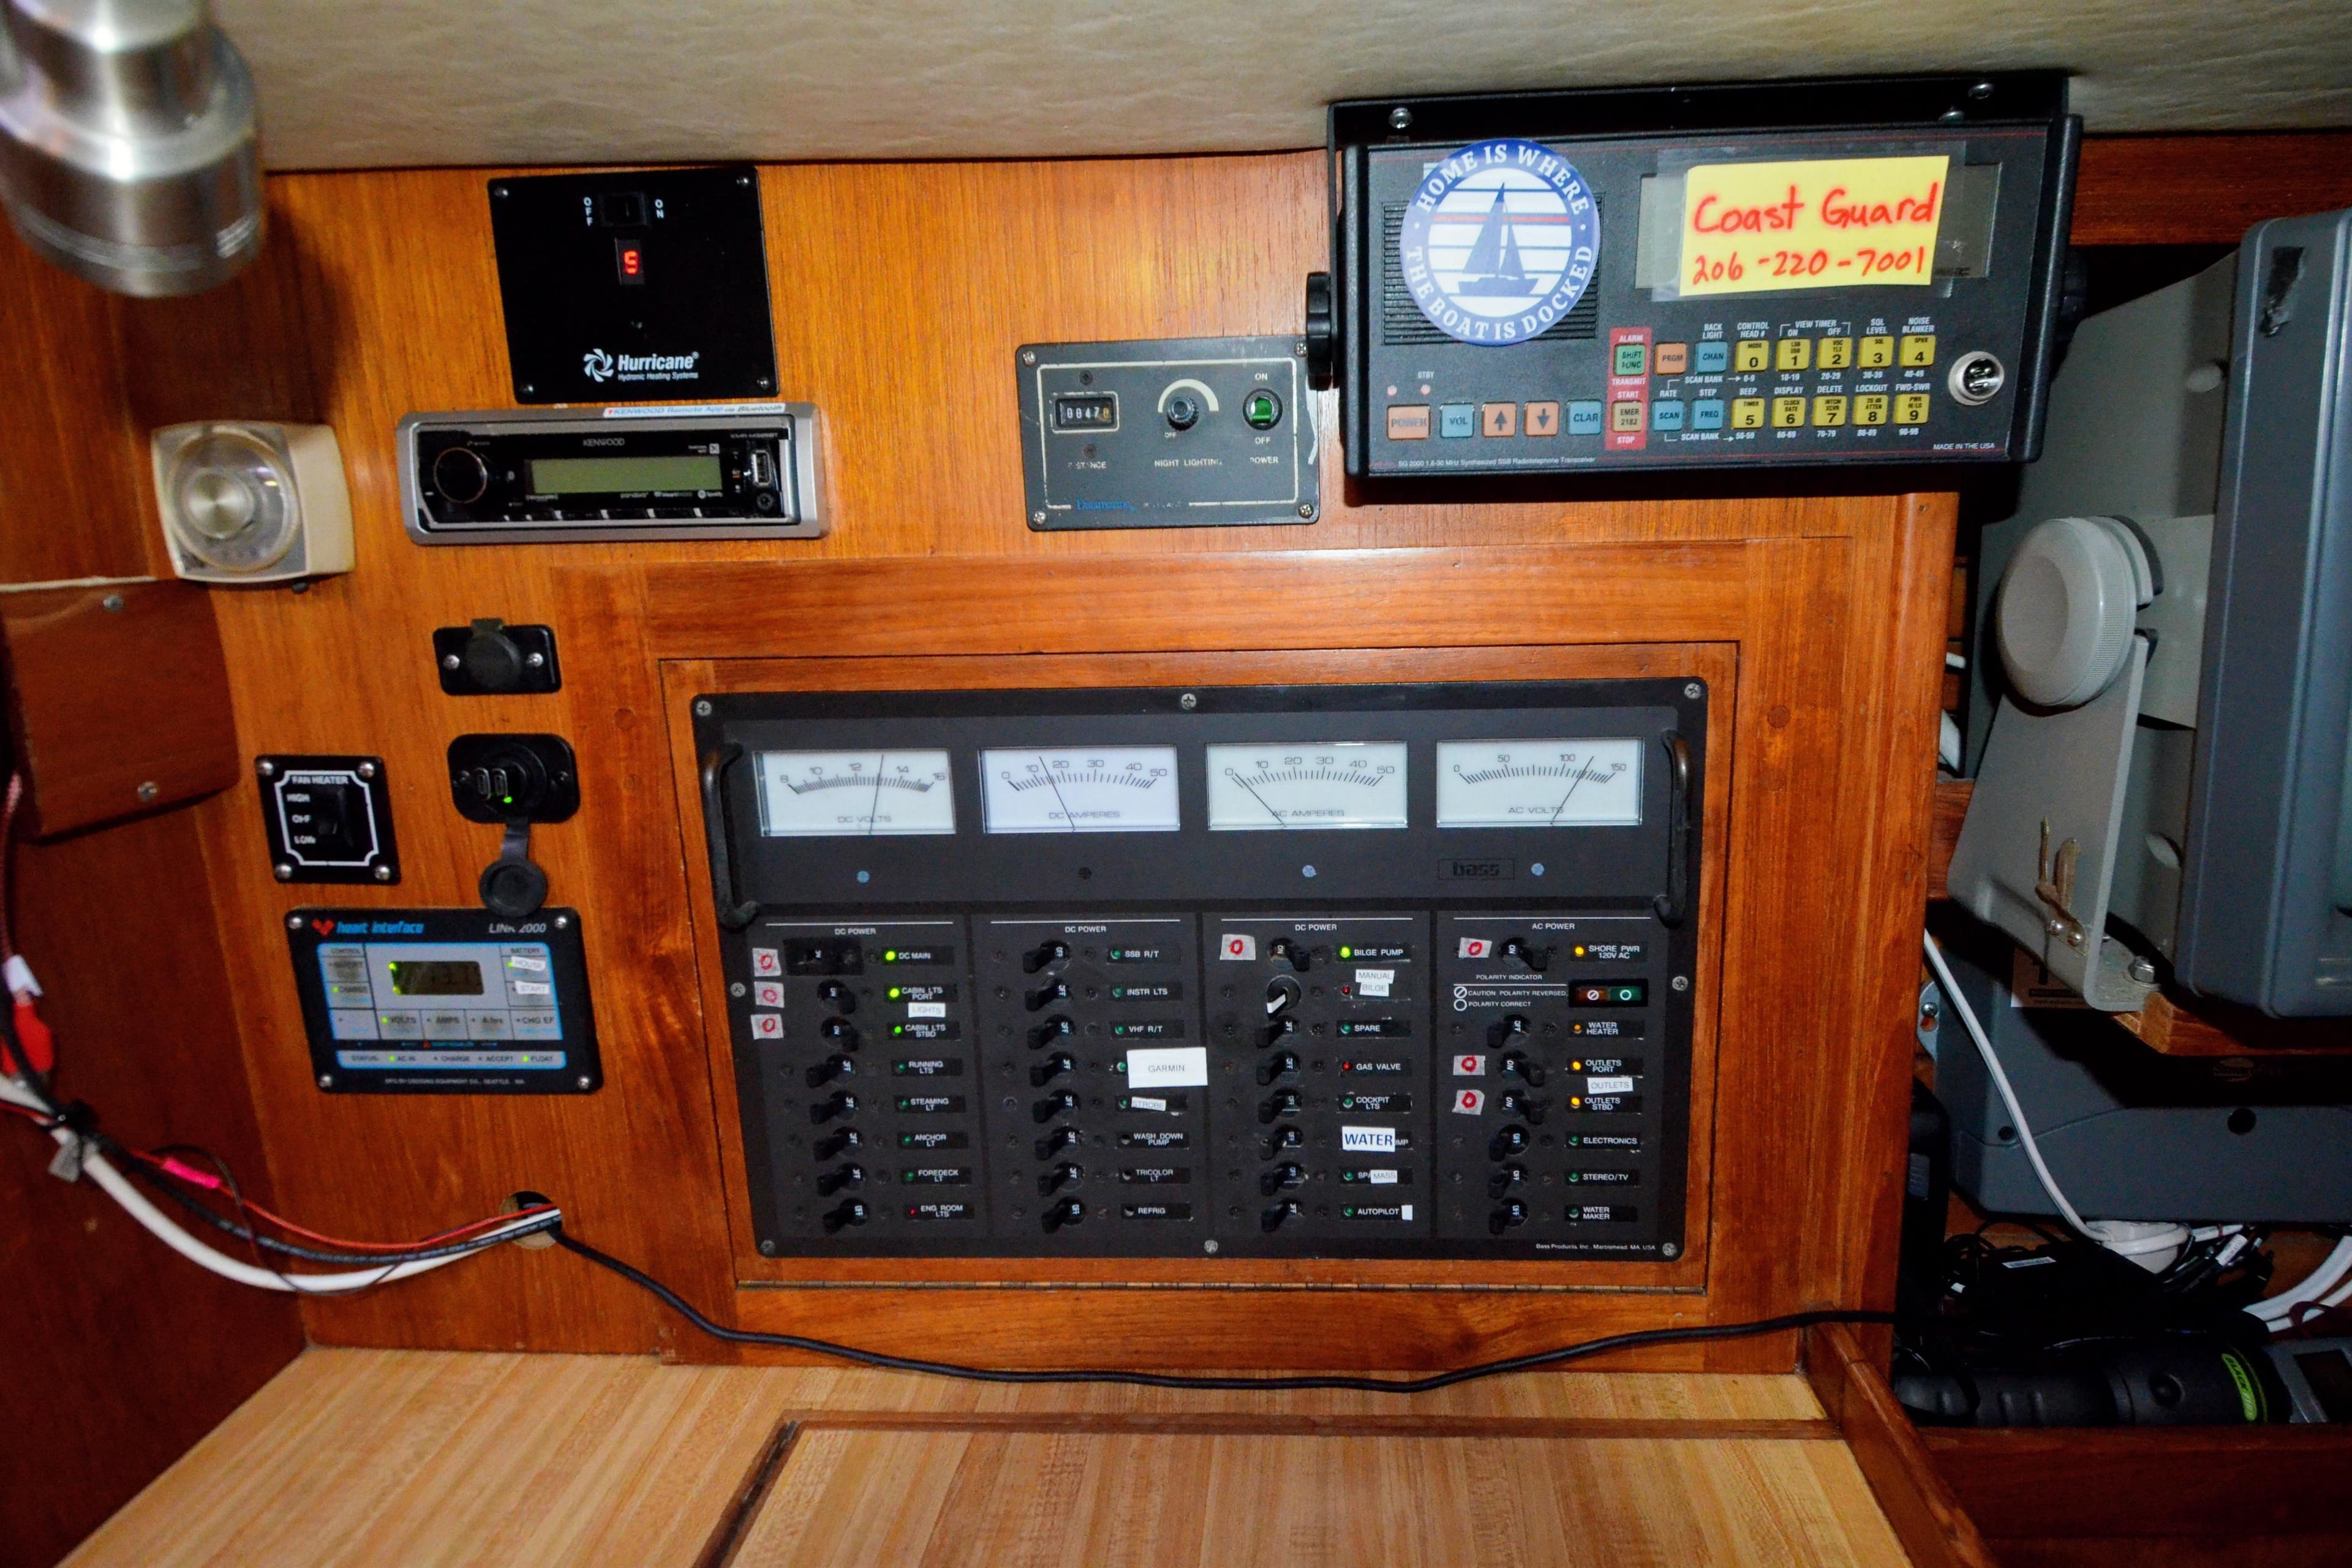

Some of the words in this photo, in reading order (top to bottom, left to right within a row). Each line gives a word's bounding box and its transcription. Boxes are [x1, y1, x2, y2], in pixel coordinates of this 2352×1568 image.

[1415, 151, 1479, 213] HOME
[1484, 145, 1507, 164] IS
[1518, 145, 1589, 216] WHERE
[583, 197, 593, 227] OFF
[655, 198, 665, 219] ON
[1694, 184, 1804, 234] Coast
[1821, 183, 1938, 230] Guard
[1407, 246, 1434, 297] THE
[1429, 296, 1489, 339] BOAT
[1494, 322, 1516, 339] IS
[1522, 246, 1592, 333] DOCKED
[1909, 317, 1929, 325] NOISE
[1902, 325, 1934, 333] BLANKER
[618, 372, 645, 382] Hydronic
[647, 372, 671, 382] Heating
[672, 371, 699, 380] Systems
[1255, 372, 1268, 381] ON
[1774, 386, 1803, 394] DISPLAY
[1856, 384, 1888, 393] LOCKOUT
[1896, 383, 1930, 392] FWD-SWR
[614, 407, 665, 415] KENWOOD
[705, 405, 723, 413] App
[1066, 406, 1109, 420] 00470
[1450, 416, 1468, 425] VOL
[1574, 413, 1598, 423] CLAR
[1255, 436, 1271, 445] OFF
[292, 776, 311, 785] FAN
[312, 775, 349, 785] HEATER
[780, 774, 788, 783] 8
[287, 793, 310, 802] HIGH
[1452, 862, 1500, 876] bass
[337, 921, 368, 934] heart
[372, 921, 425, 935] interface
[519, 923, 547, 933] 2000
[1148, 1064, 1185, 1072] GARMIN
[1591, 1081, 1630, 1090] OUTLETS
[1344, 1133, 1393, 1147] WATER
